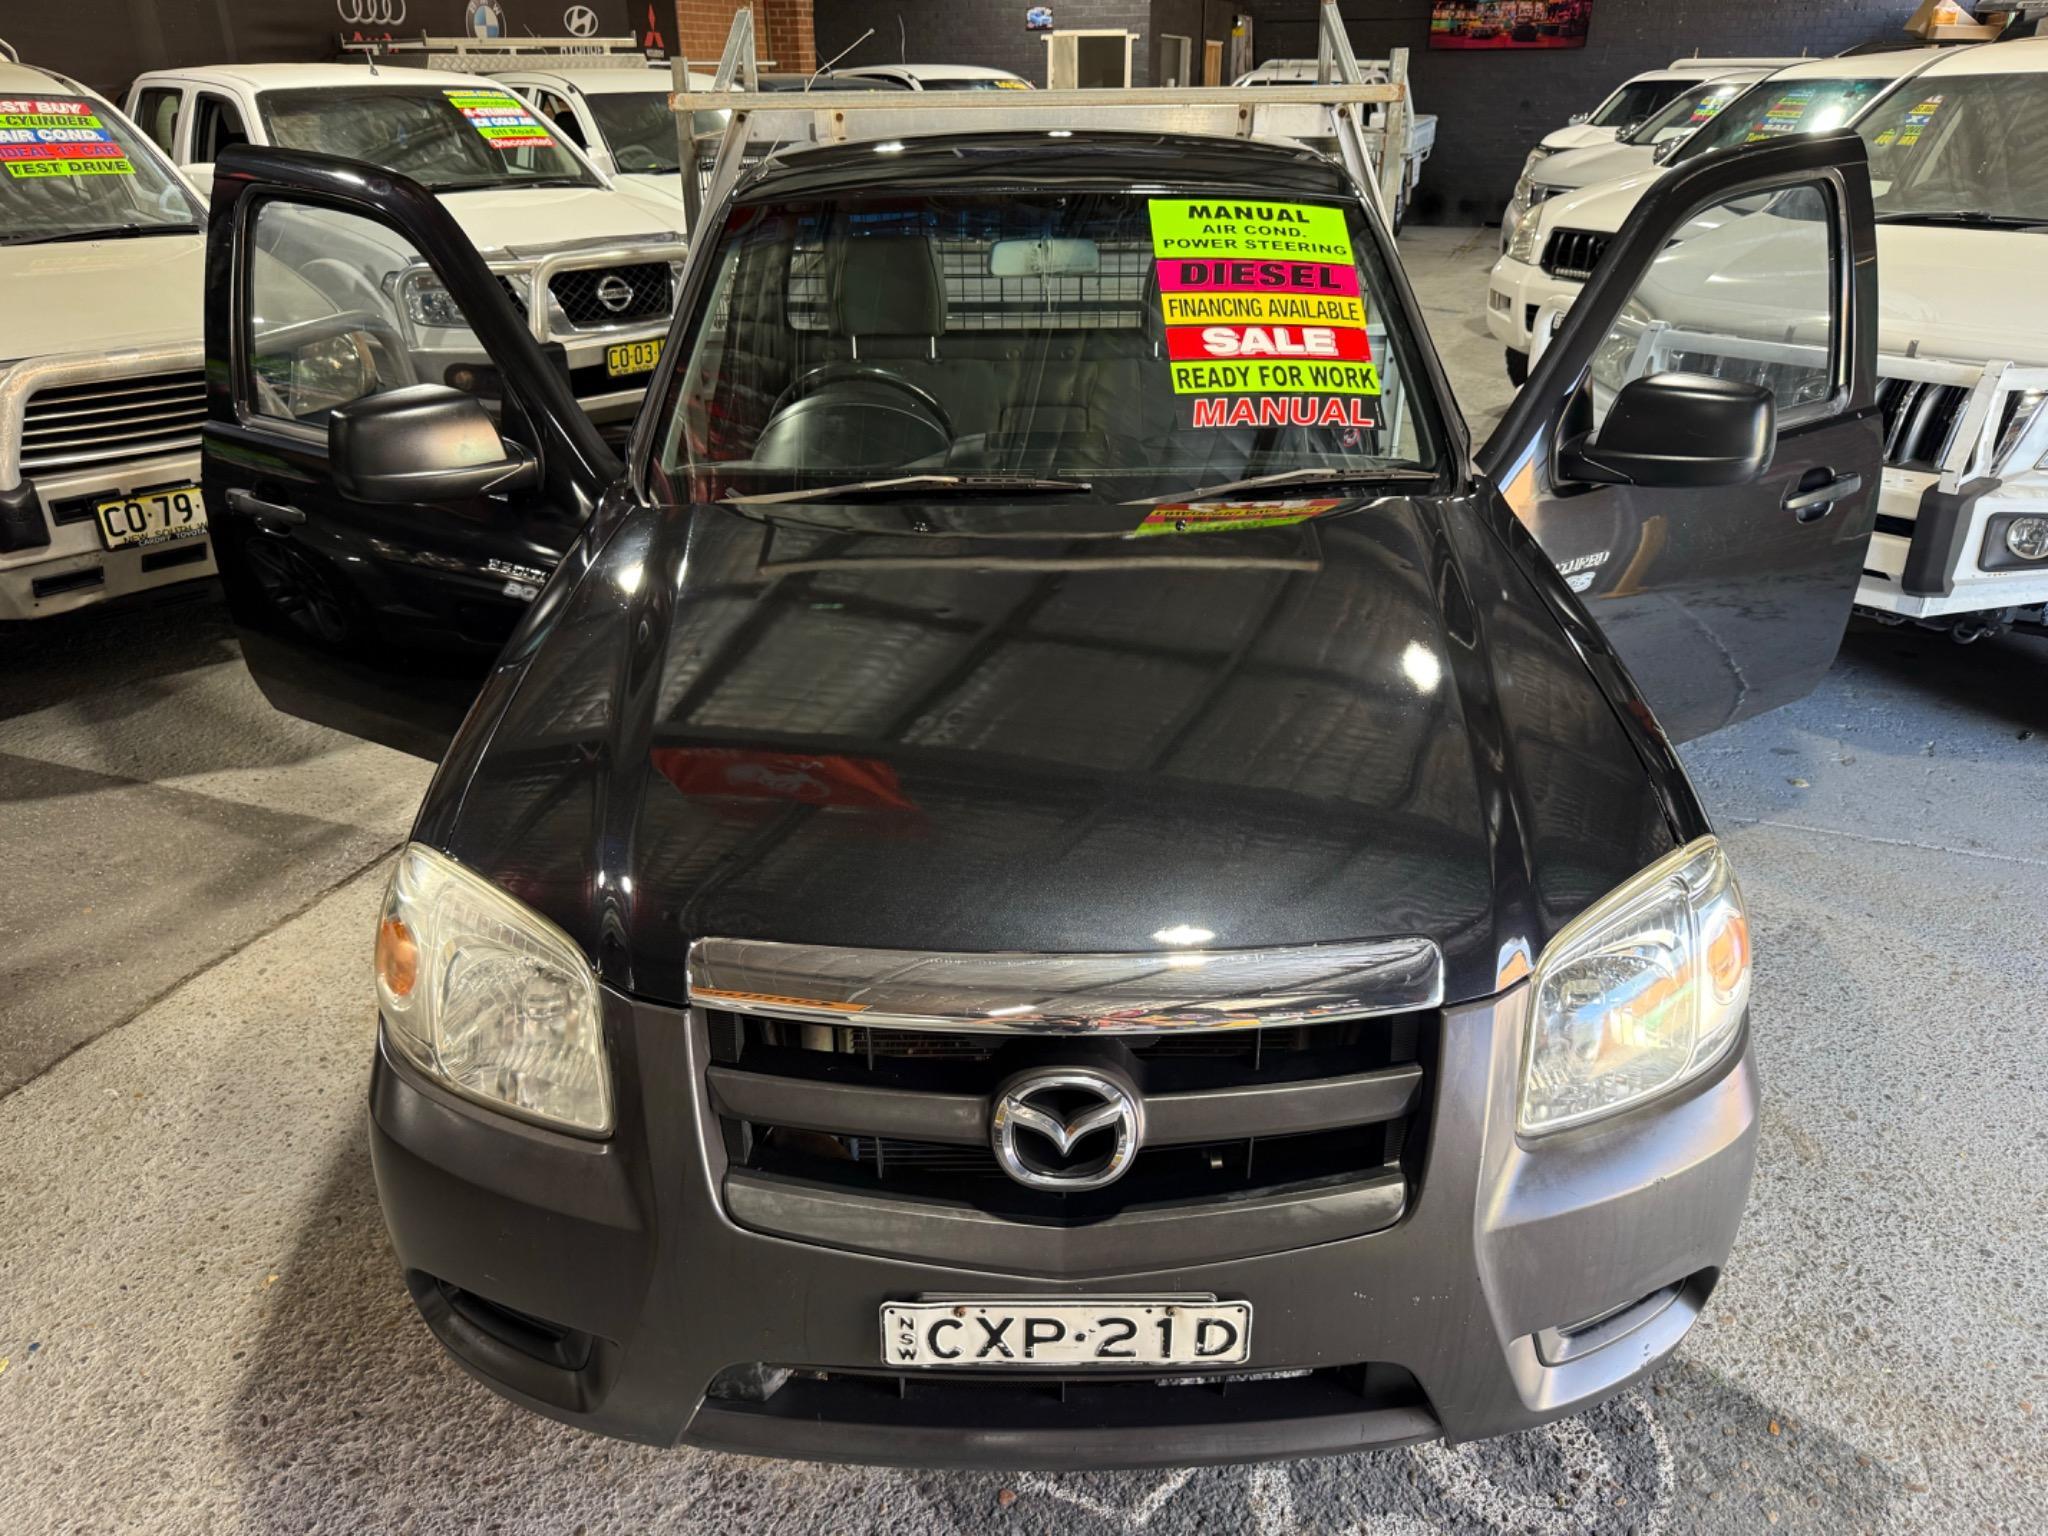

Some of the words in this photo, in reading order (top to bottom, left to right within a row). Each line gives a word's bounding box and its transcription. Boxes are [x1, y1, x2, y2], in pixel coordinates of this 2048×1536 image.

[37, 102, 82, 114] BUY
[37, 130, 104, 142] COND.
[79, 145, 118, 156] CAR
[9, 162, 63, 175] TEST
[68, 160, 129, 173] DRIVE
[1188, 205, 1310, 223] MANUAL
[1202, 224, 1237, 235] AIR
[1244, 225, 1308, 238] COND.
[1163, 239, 1237, 250] POWER
[1245, 239, 1348, 256] STEERING
[1179, 262, 1343, 289] DIESEL
[1168, 297, 1264, 319] FINANCING
[1268, 299, 1361, 321] AVAILABLE
[1201, 327, 1339, 356] SALE
[1176, 365, 1250, 390] READY
[1258, 365, 1304, 388] FOR
[1308, 366, 1376, 390] WORK
[1192, 396, 1375, 428] MANUAL
[899, 1317, 916, 1360] NSW
